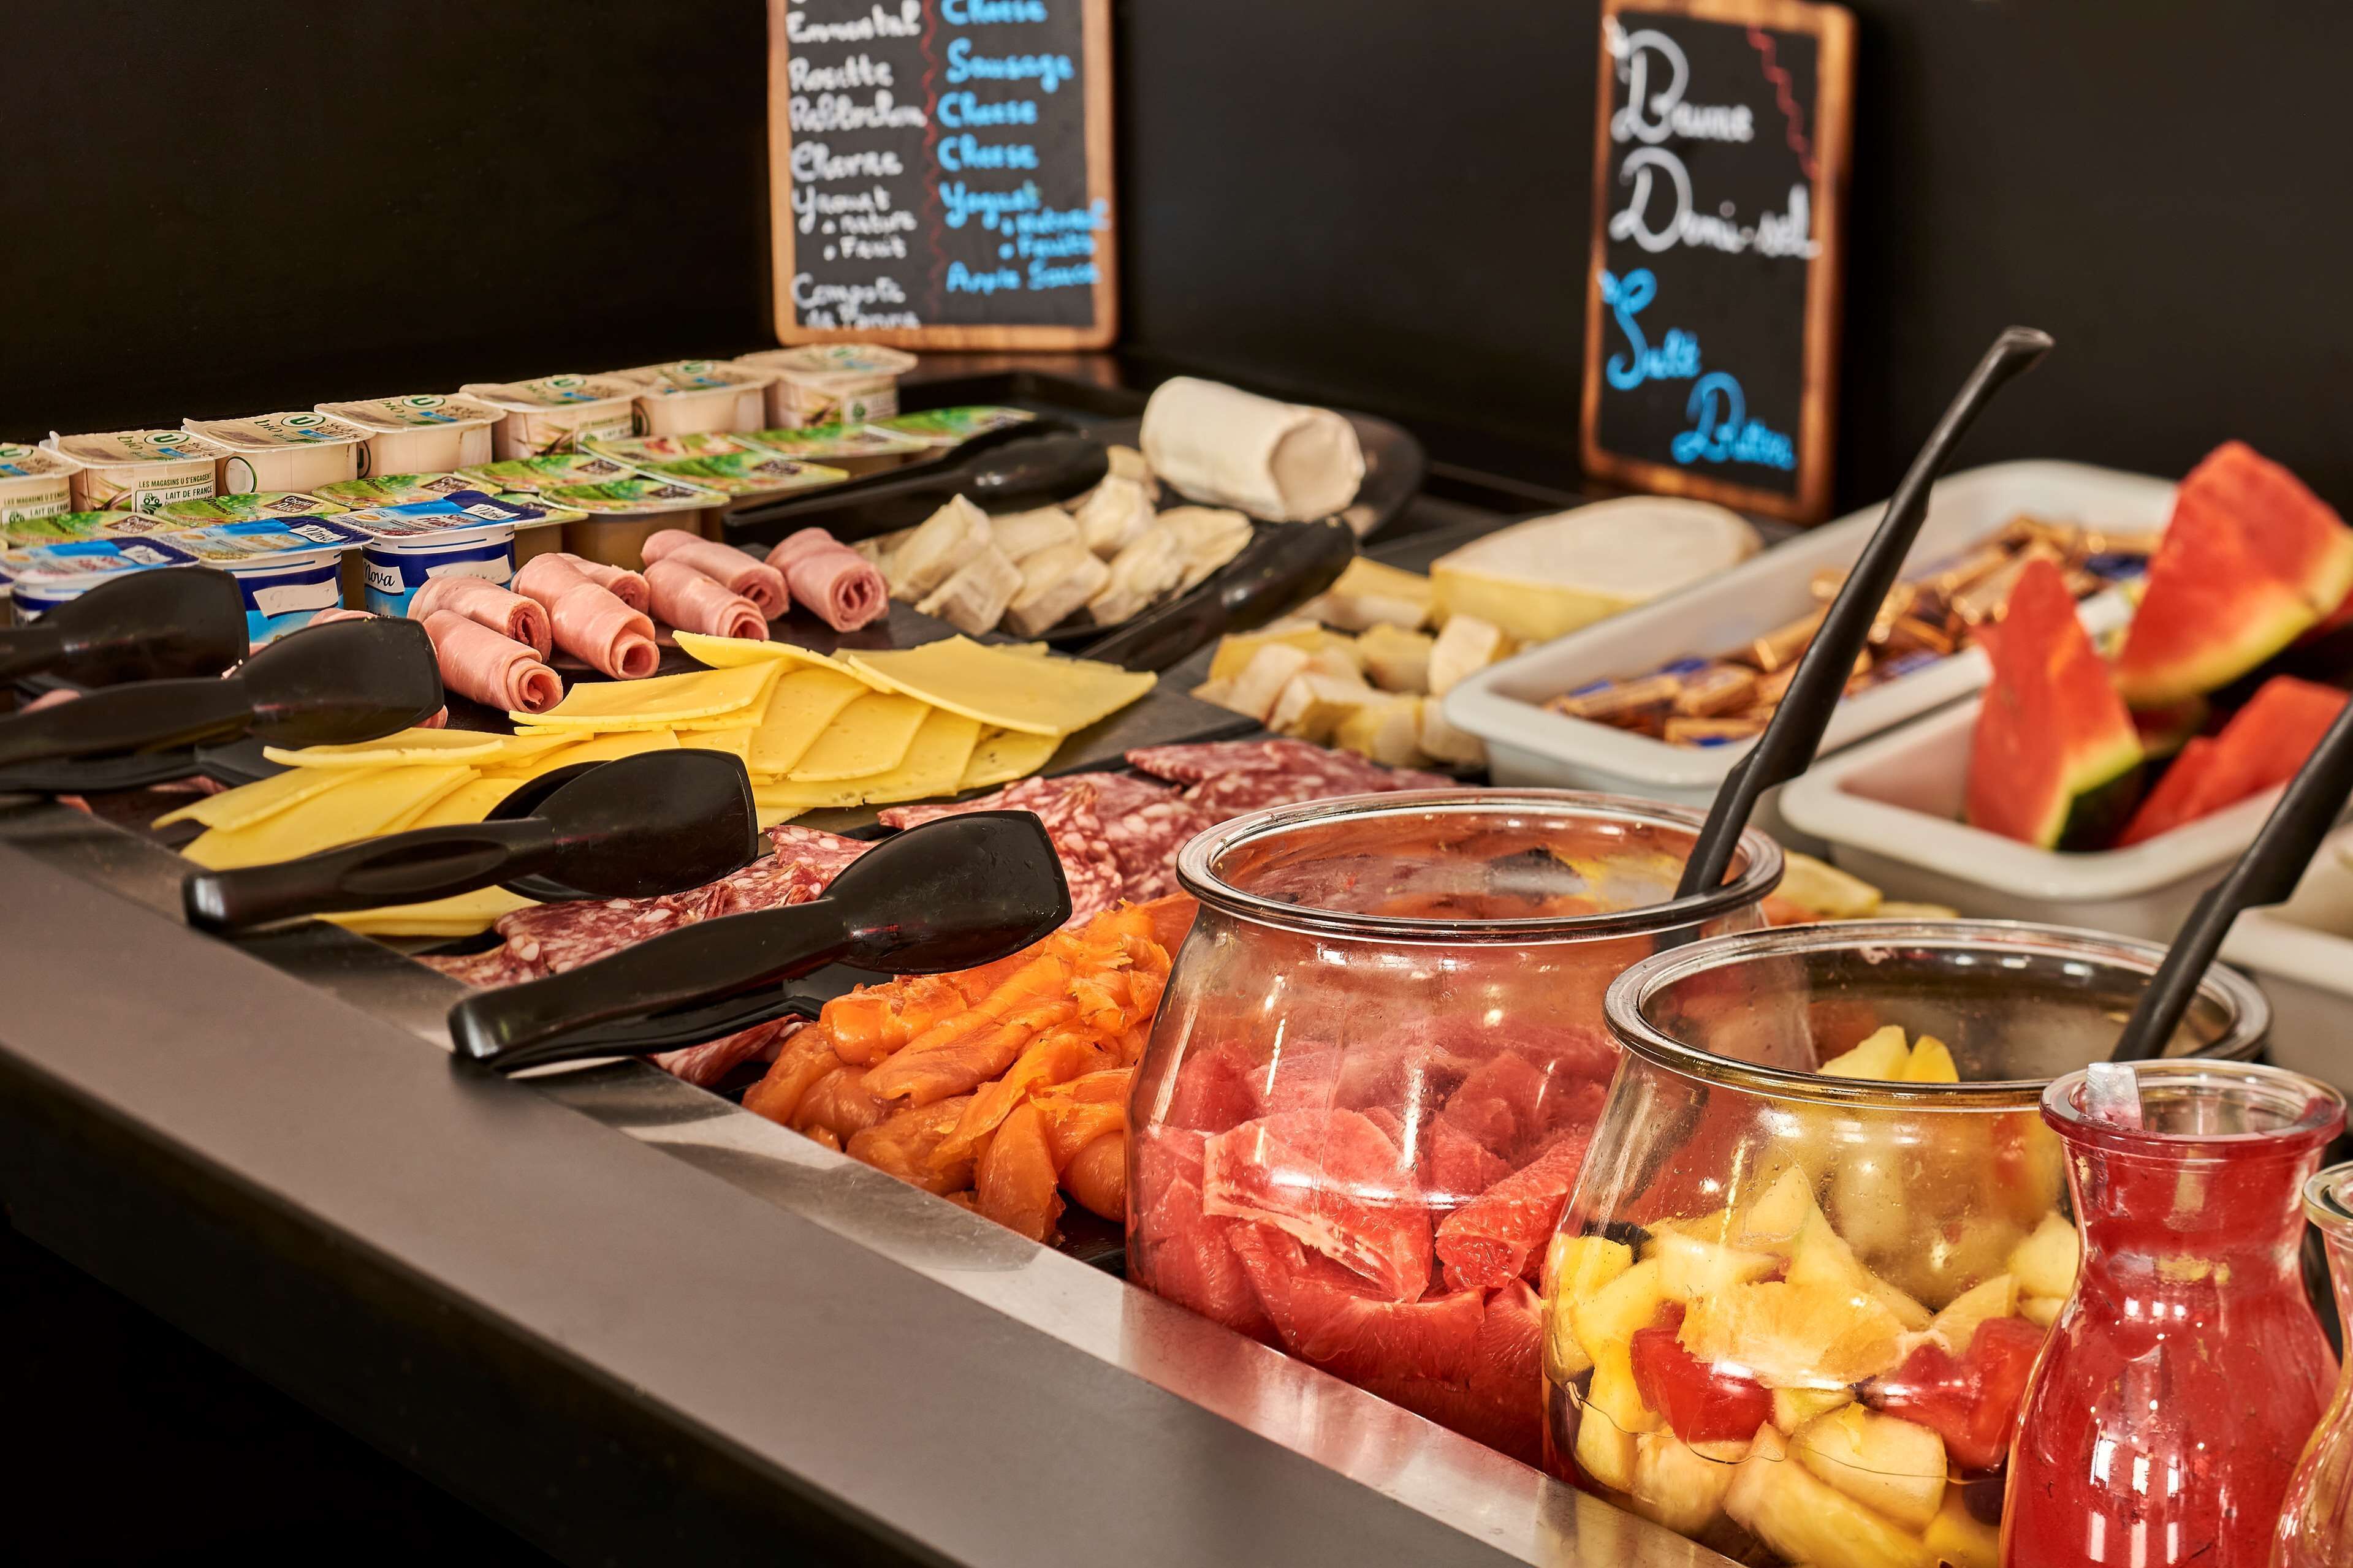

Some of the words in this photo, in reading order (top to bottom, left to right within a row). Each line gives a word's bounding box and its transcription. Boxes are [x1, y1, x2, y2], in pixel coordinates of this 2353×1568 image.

[254, 419, 283, 433] bio
[139, 479, 150, 488] LES
[151, 478, 179, 487] MAGASINS
[186, 472, 211, 484] S'ENGAGENT
[165, 491, 181, 499] LAIT
[193, 485, 212, 496] FRANCE
[284, 496, 314, 507] Charles
[363, 562, 395, 586] Nova
